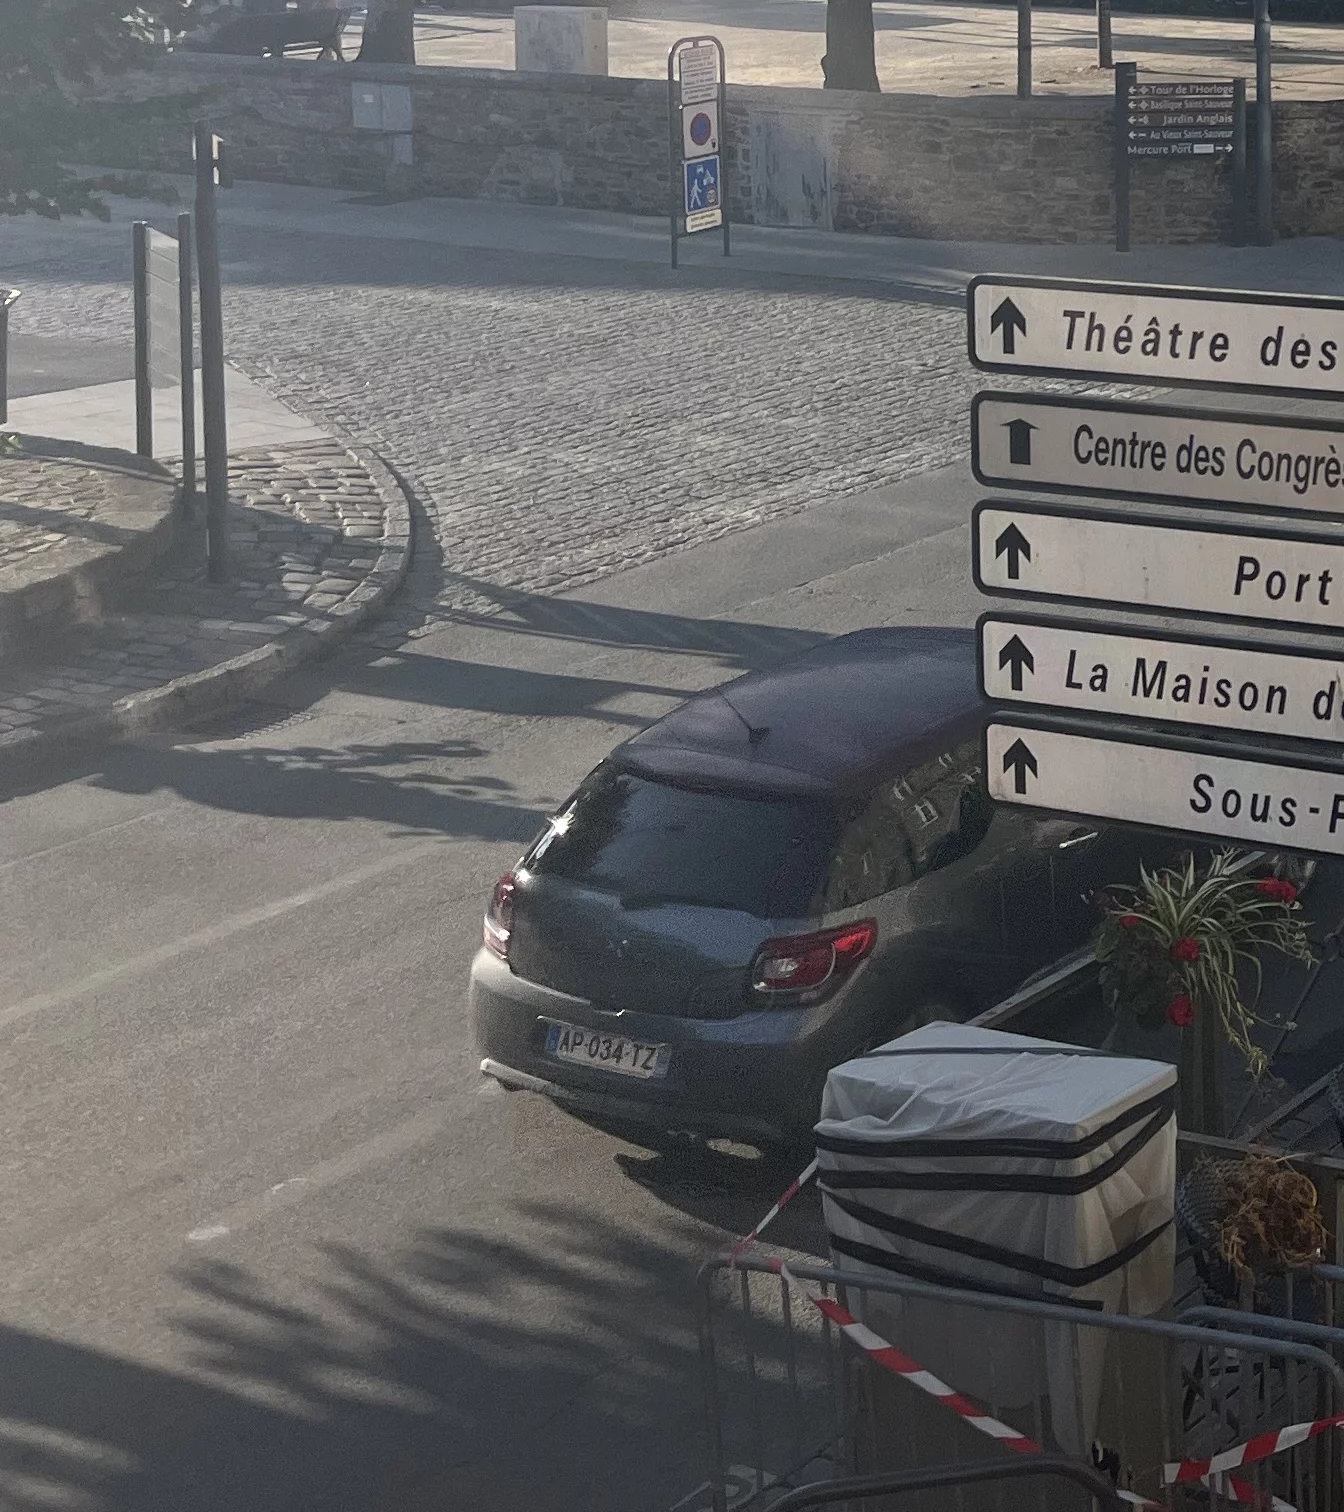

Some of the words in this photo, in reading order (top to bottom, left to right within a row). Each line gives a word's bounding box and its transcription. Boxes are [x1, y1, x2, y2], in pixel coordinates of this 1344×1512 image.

[1150, 85, 1174, 95] Tour
[1175, 84, 1187, 94] de
[1162, 114, 1194, 126] Jardin
[1196, 113, 1233, 126] Anglais
[1127, 145, 1169, 155] Mercure
[1171, 144, 1193, 154] Port
[1062, 309, 1231, 363] Théâtre
[1259, 325, 1339, 372] des
[1073, 423, 1167, 473] Centre
[1175, 433, 1226, 478] des
[1232, 555, 1334, 606] Port
[1064, 648, 1110, 694] La
[1130, 656, 1289, 716] Maison
